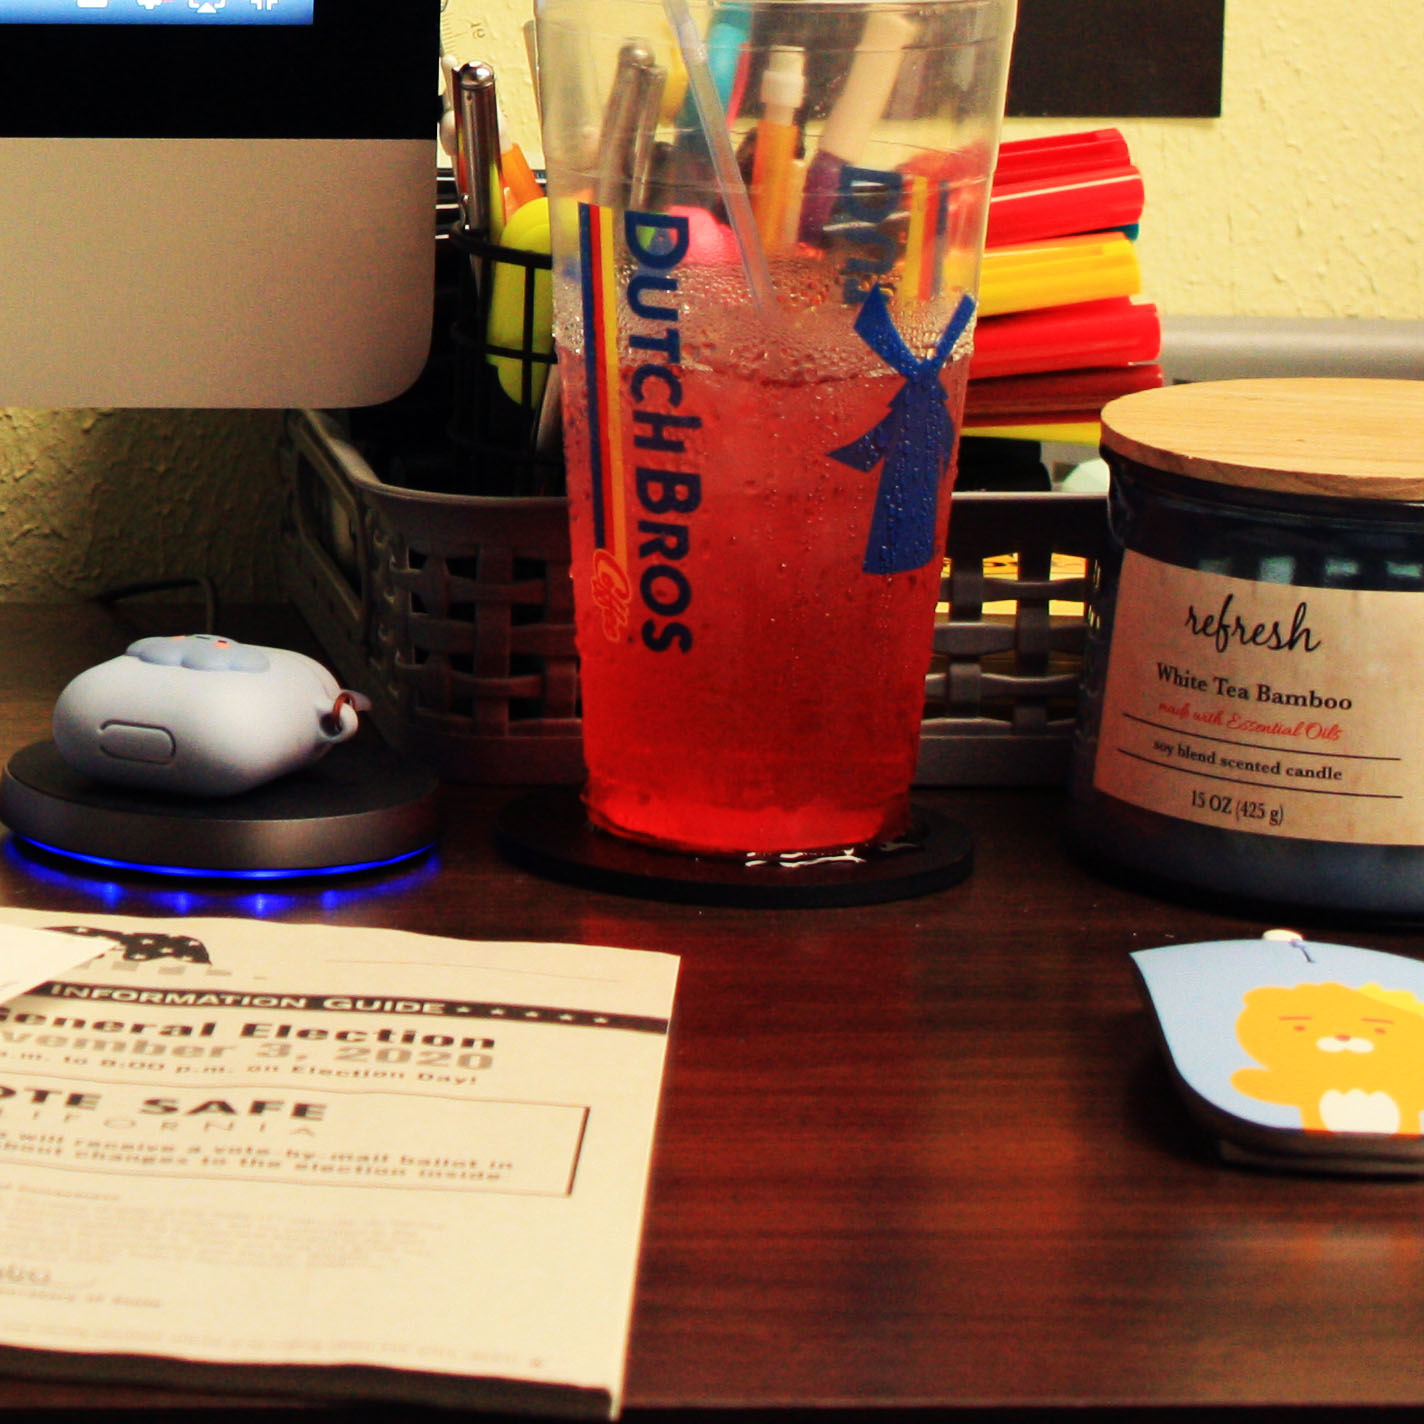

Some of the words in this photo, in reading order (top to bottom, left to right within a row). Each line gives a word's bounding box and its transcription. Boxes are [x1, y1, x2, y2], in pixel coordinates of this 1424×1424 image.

[625, 210, 703, 456] DUTCH
[635, 466, 702, 655] BROS
[1185, 593, 1322, 653] refresh
[1156, 662, 1208, 692] White
[1213, 676, 1249, 700] Tea
[1255, 684, 1353, 710] Bamboo
[1158, 700, 1191, 718] made
[1192, 710, 1224, 726] with
[1226, 715, 1303, 738] Essential
[1303, 723, 1344, 742] Oils
[1153, 740, 1173, 756] soy
[1178, 745, 1216, 764] blend
[1220, 754, 1281, 775] scented
[1286, 766, 1343, 781] candle
[1191, 789, 1206, 808] 15
[1209, 794, 1233, 815] OZ
[1235, 799, 1266, 821] (425
[1269, 804, 1284, 826] g)
[50, 982, 308, 1010] INFORMATION
[322, 997, 447, 1015] GUIDE
[239, 1021, 496, 1051] Election
[255, 1041, 309, 1063] 3,
[333, 1044, 495, 1071] 2020
[137, 1096, 328, 1122] SAFE
